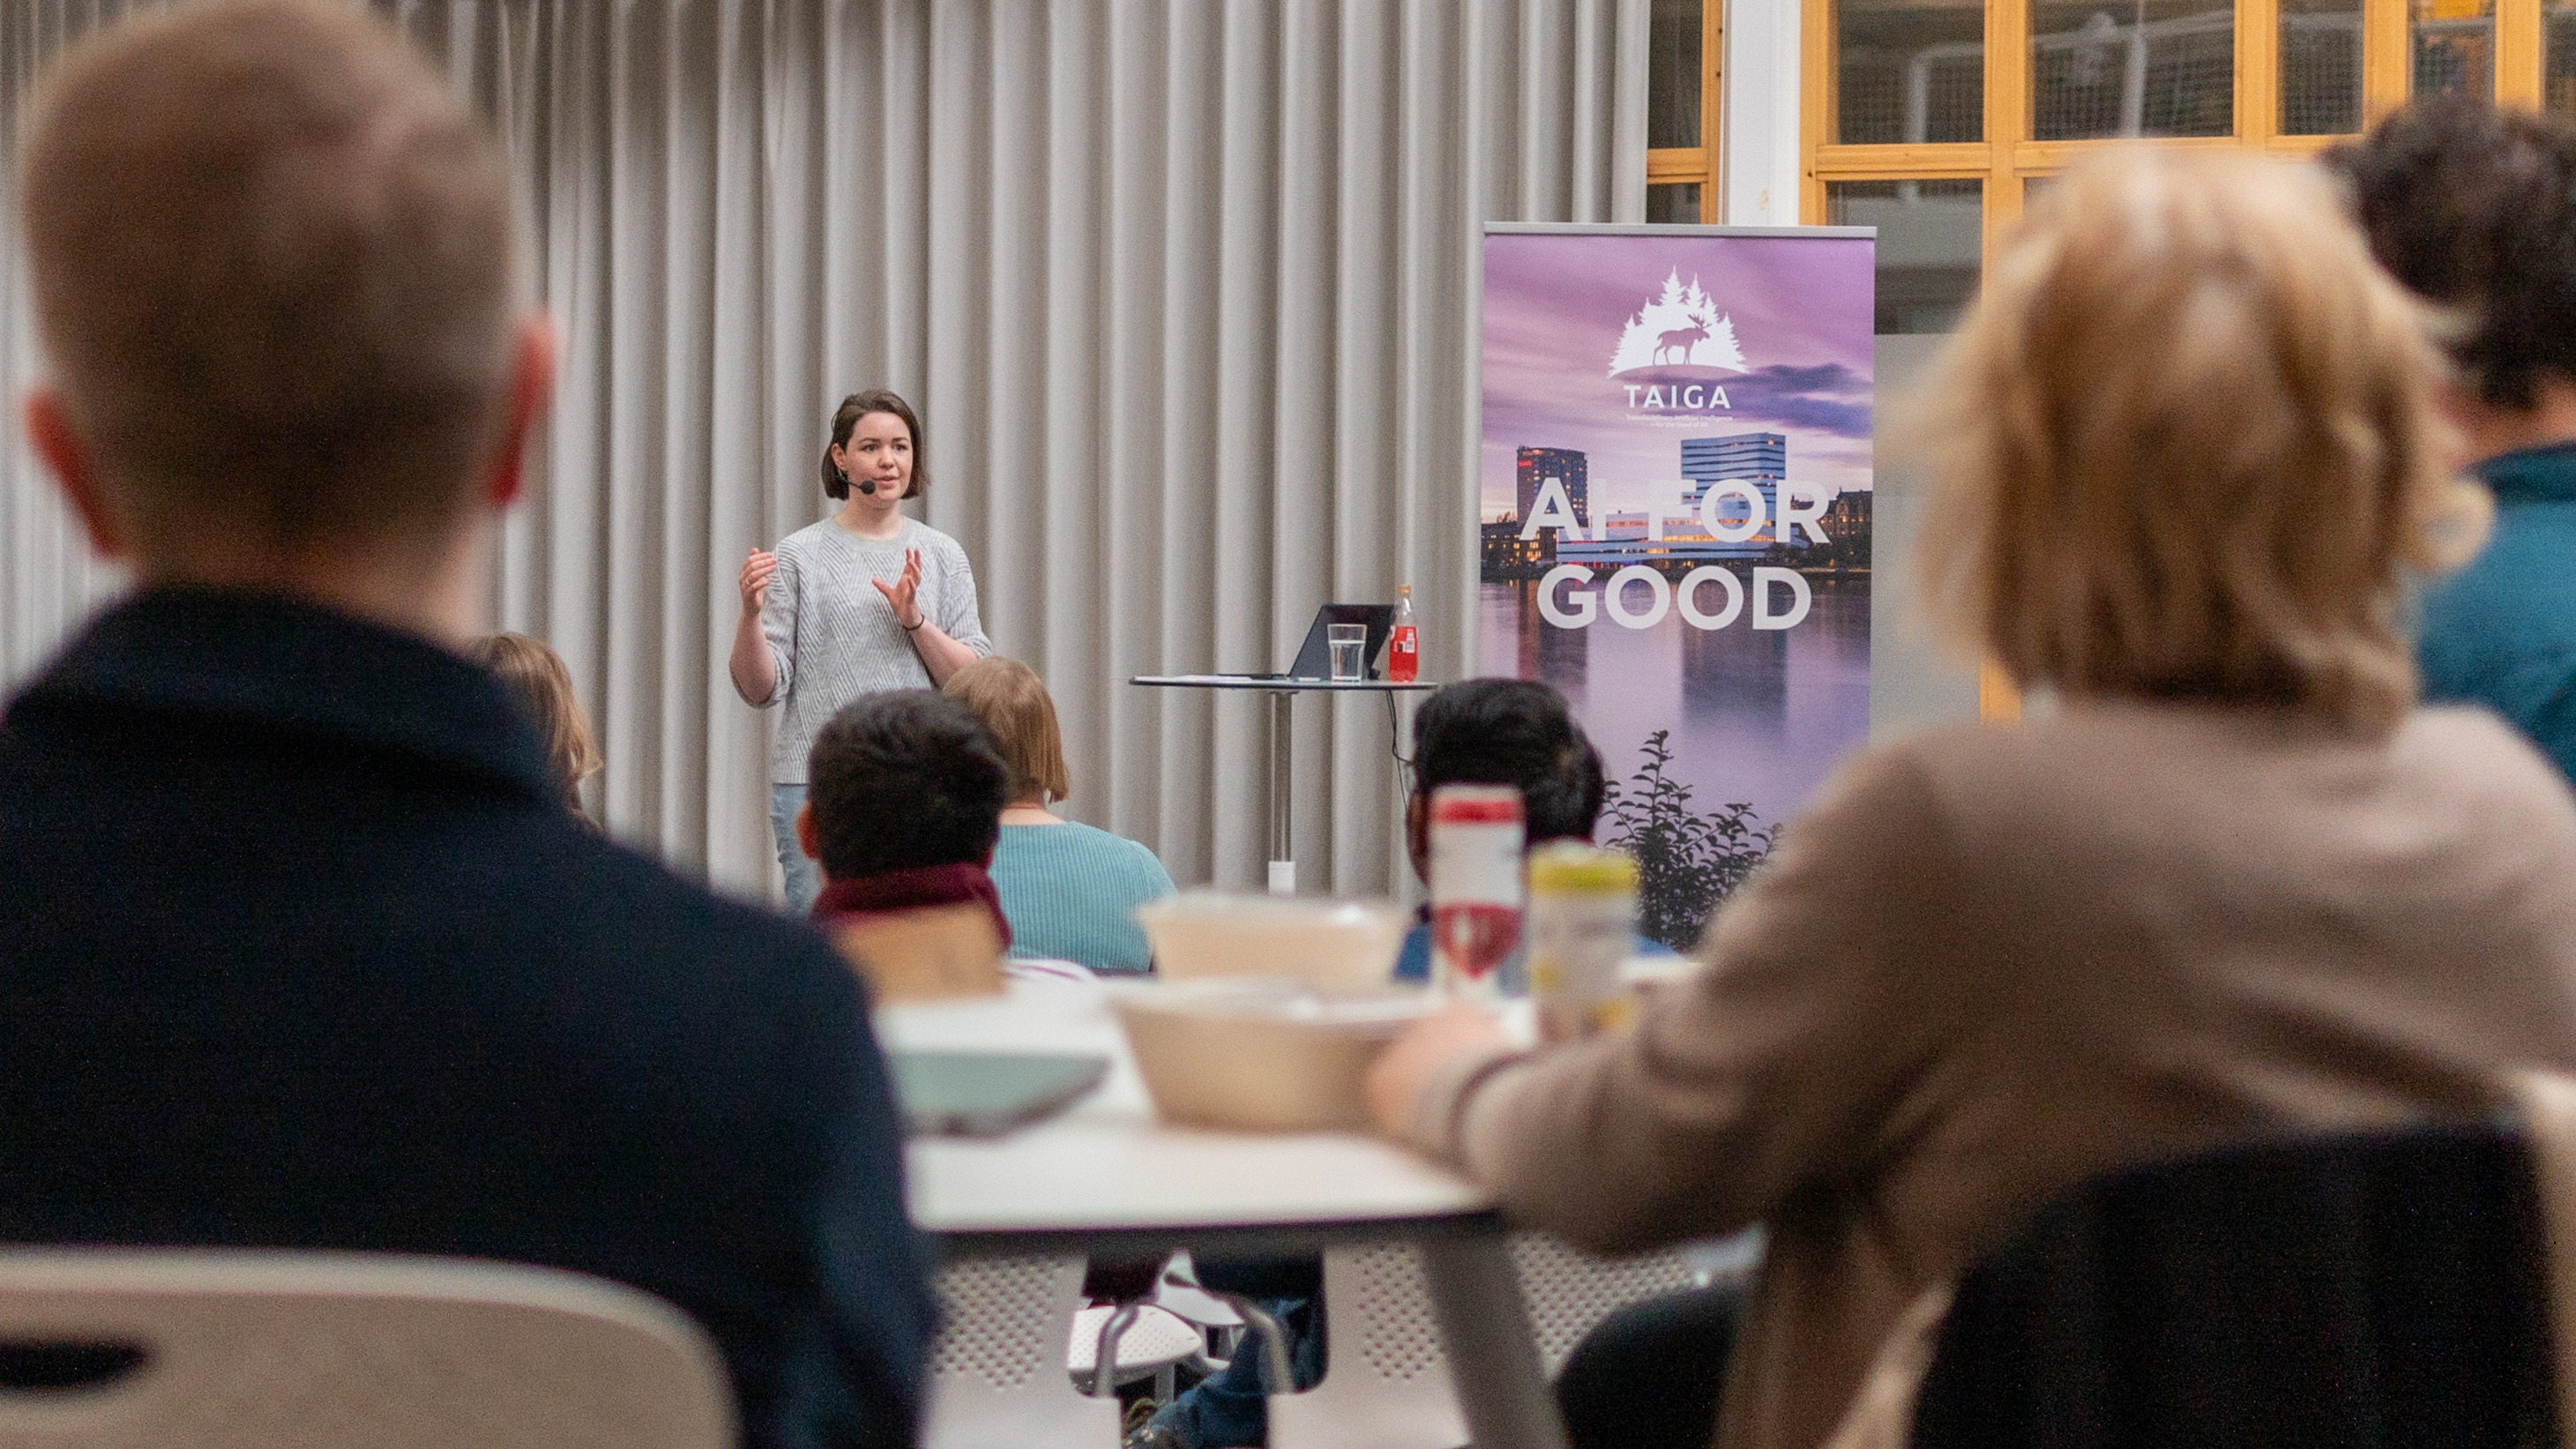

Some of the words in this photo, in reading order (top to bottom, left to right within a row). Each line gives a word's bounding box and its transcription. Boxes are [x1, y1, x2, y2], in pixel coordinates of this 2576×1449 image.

[1624, 385, 1731, 409] TAIGA
[1519, 477, 1607, 541] AI
[1649, 478, 1830, 544] FOR
[1537, 564, 1811, 631] GOOD
